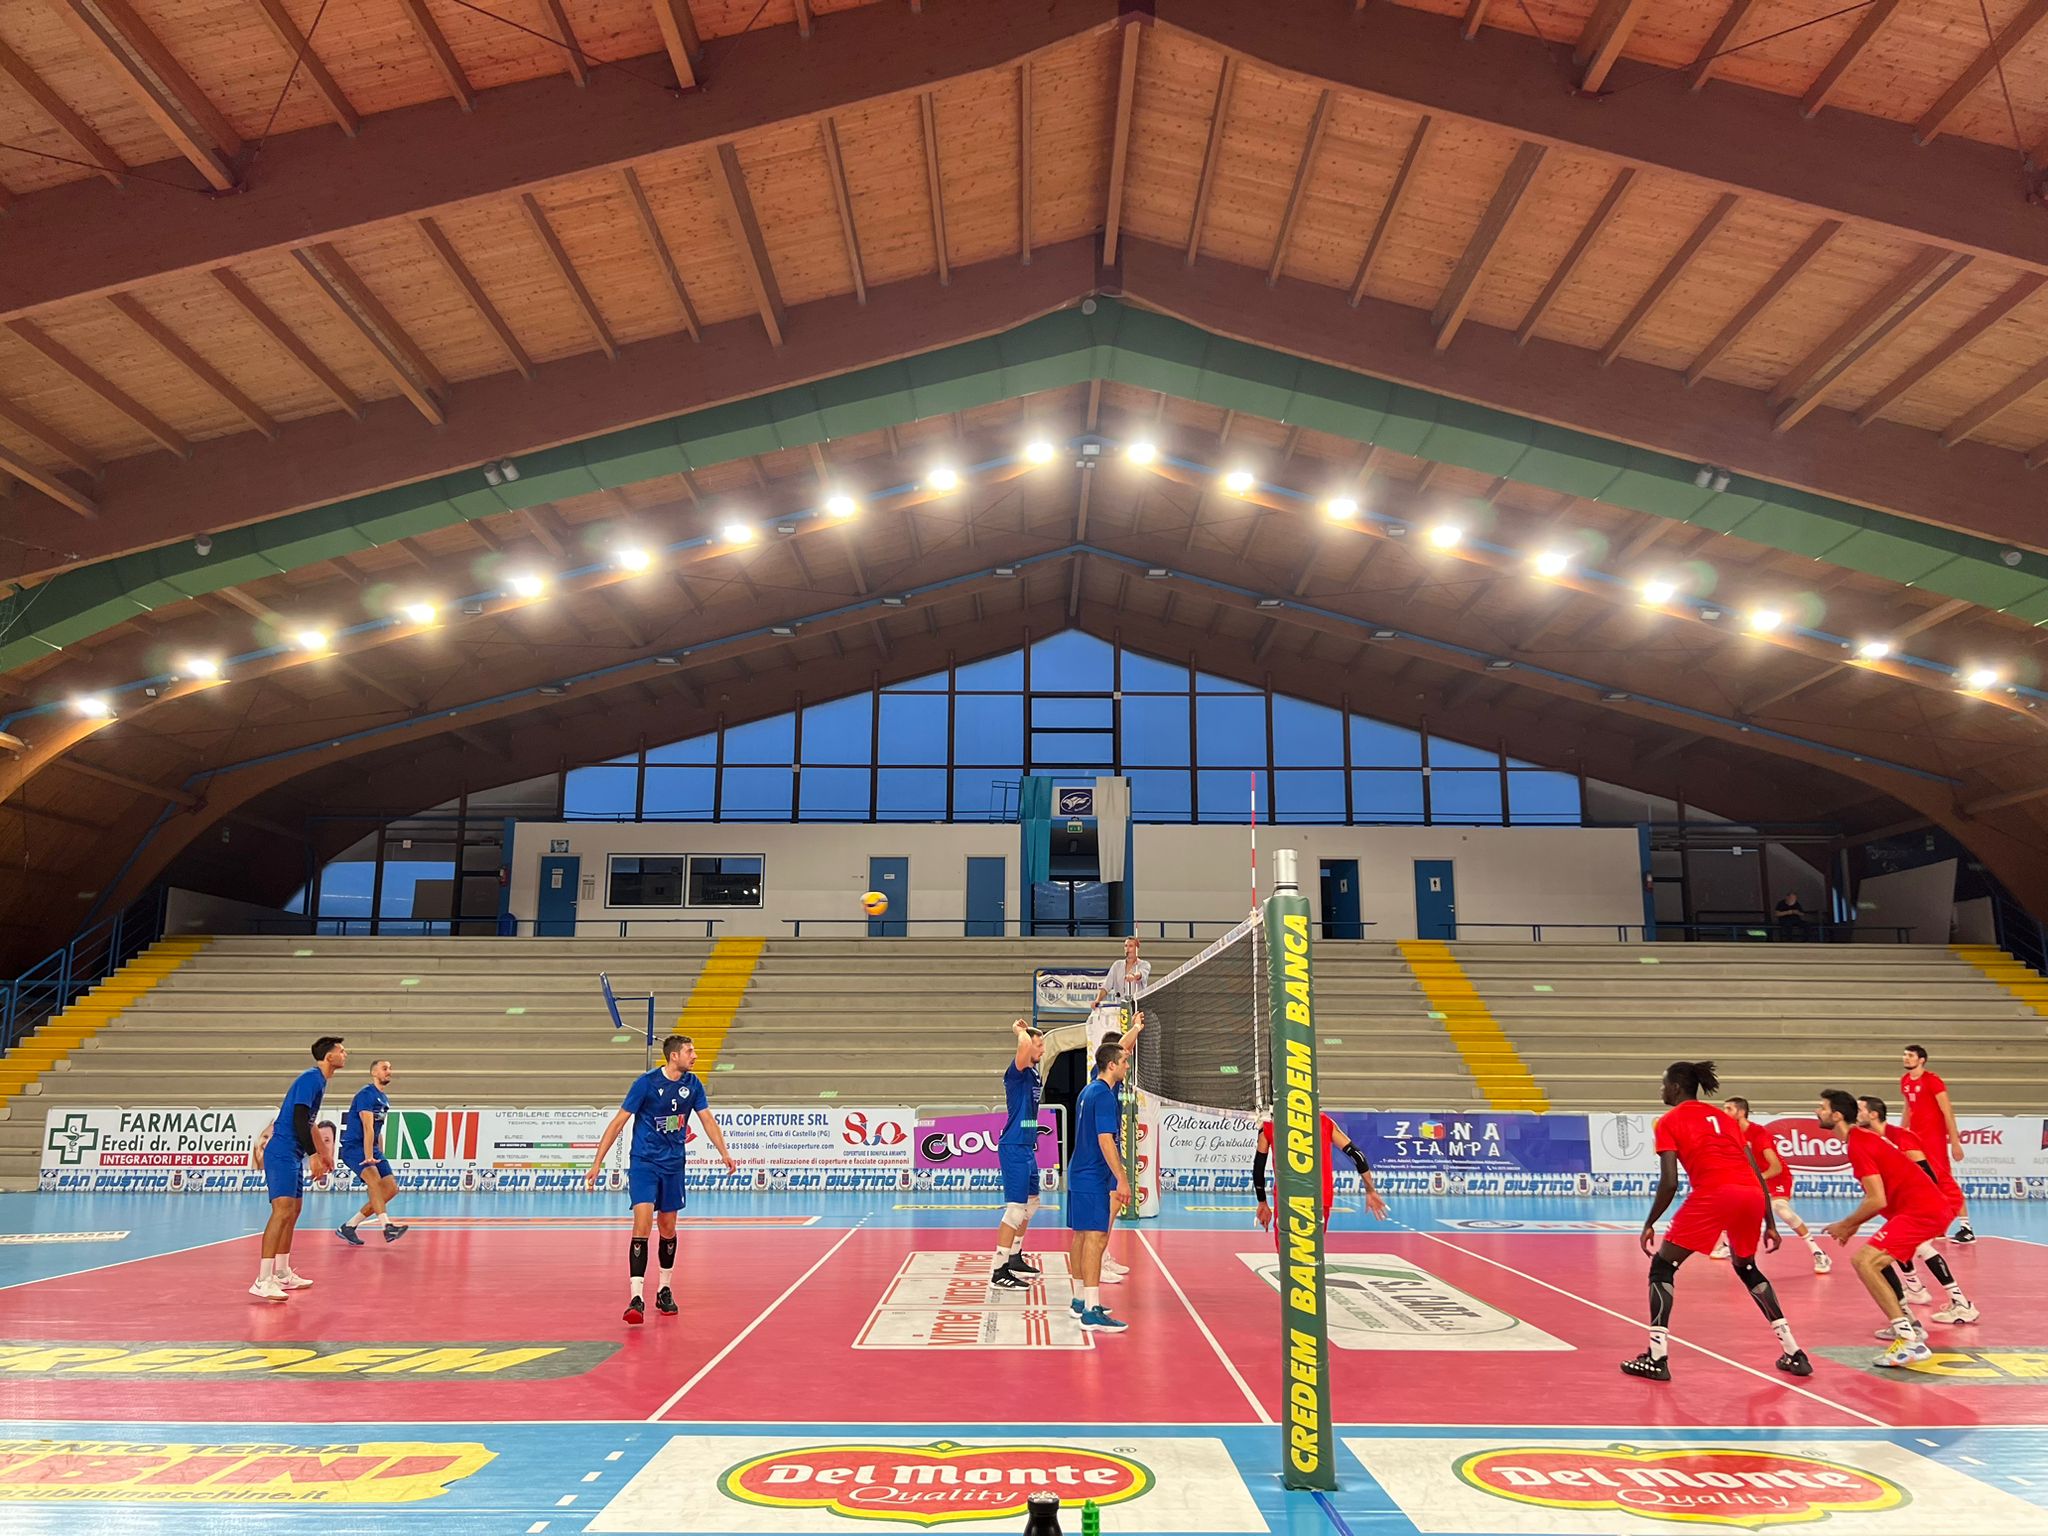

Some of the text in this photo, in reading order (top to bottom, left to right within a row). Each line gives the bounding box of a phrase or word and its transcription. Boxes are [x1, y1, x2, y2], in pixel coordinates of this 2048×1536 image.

[1121, 1008, 1129, 1034] NCA
[1283, 914, 1314, 1174] CREDEM BANCA
[671, 1098, 677, 1111] 5
[119, 1113, 238, 1133] FARMACIA
[714, 1113, 829, 1126] SIA COPERTURE SRL
[1163, 1113, 1231, 1133] Ristorante
[817, 1130, 831, 1138] (PG)
[1957, 1129, 2003, 1145] OTEK
[101, 1135, 252, 1151] Eredi dr. Polverini
[1170, 1136, 1193, 1148] Corso
[1194, 1136, 1207, 1150] G.
[1395, 1141, 1501, 1157] STAMPA
[103, 1154, 247, 1166] INTEGRATORI PER LO SPORT
[685, 1157, 708, 1165] accolta
[747, 1157, 766, 1165] rifiuti
[770, 1157, 811, 1165] realizzazione
[811, 1157, 818, 1165] di
[819, 1158, 848, 1167] coperture
[854, 1157, 877, 1165] facciate
[878, 1158, 910, 1167] capannoni
[1210, 1154, 1227, 1162] 075
[57, 1175, 169, 1187] SAN GIUSTINO
[204, 1176, 239, 1188] SAN
[394, 1176, 461, 1187] IUSTINO
[498, 1175, 607, 1187] SAN GIUSTIO
[789, 1175, 897, 1187] SAN GIUSTINO
[933, 1175, 1004, 1187] SAN GIUS
[1177, 1175, 1209, 1187] SAN
[1333, 1178, 1354, 1189] AN
[1467, 1179, 1574, 1191] SAN GIUSTINO
[1611, 1180, 1643, 1191] SAN
[929, 1277, 989, 1305] vimer
[912, 1309, 983, 1346] vimer
[1288, 1196, 1318, 1474] CREDEM BANCA
[0, 1347, 567, 1373] REDEM
[765, 1463, 1120, 1487] Del Monte
[1491, 1466, 1864, 1491] Del Monte
[848, 1485, 1022, 1506] Quality
[1617, 1487, 1791, 1510] Quality
